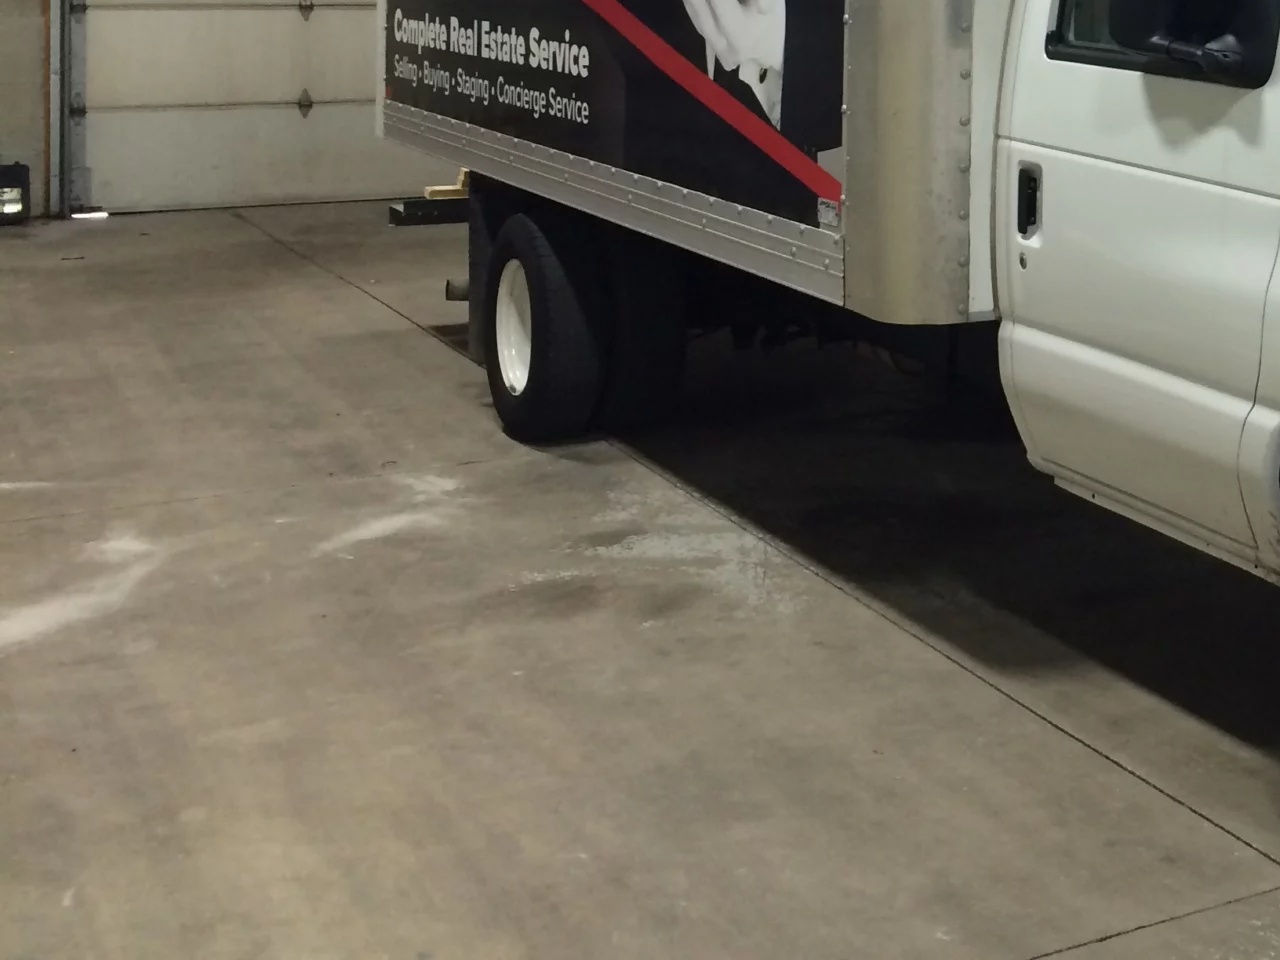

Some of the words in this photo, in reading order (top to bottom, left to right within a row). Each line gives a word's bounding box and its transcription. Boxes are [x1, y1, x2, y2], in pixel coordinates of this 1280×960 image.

[394, 8, 447, 54] Complete
[450, 16, 478, 56] Real
[481, 20, 526, 65] Estate
[529, 27, 590, 78] Service
[394, 54, 418, 87] Selling
[423, 60, 450, 95] Buying
[457, 68, 489, 106] Staging
[497, 76, 546, 119] Concierge
[549, 87, 589, 124] Service
